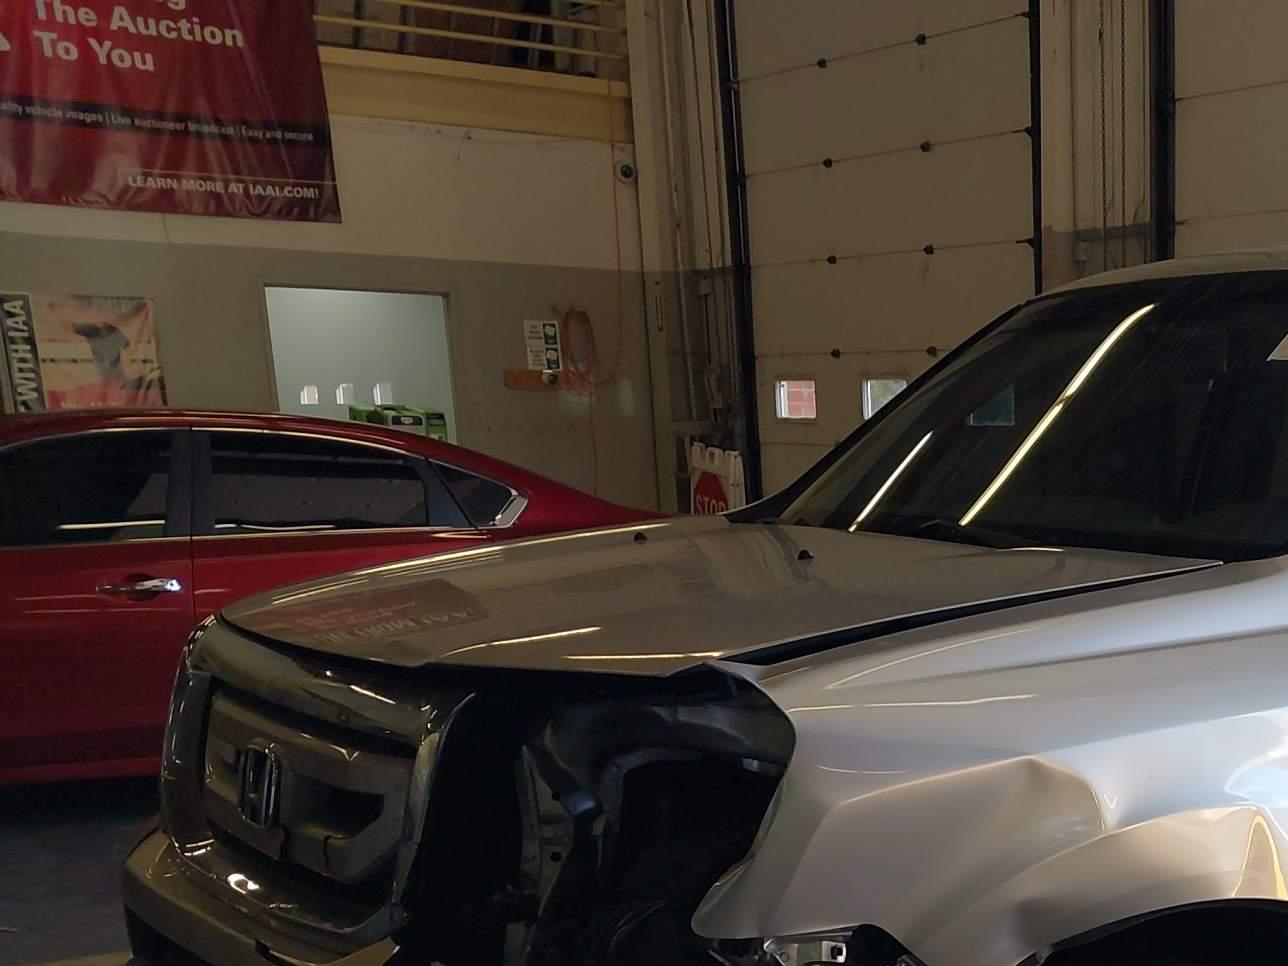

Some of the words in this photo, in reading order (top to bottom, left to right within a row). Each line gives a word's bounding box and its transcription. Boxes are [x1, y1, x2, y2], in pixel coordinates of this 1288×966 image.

[33, 0, 98, 27] The
[109, 5, 244, 47] Auction
[33, 30, 78, 61] To
[87, 37, 155, 71] You
[25, 104, 63, 118] vehicle
[66, 111, 103, 123] images
[111, 112, 131, 125] Live
[134, 117, 184, 130] auctioneer
[187, 120, 234, 135] broadcast
[241, 125, 263, 139] Easy
[265, 129, 282, 139] and
[284, 131, 313, 141] secure
[128, 175, 178, 189] LEARN
[182, 178, 224, 193] MORE
[228, 182, 245, 194] AT
[248, 182, 319, 199] IAAI.COM!
[3, 300, 29, 337] IAA
[10, 344, 39, 401] WITH
